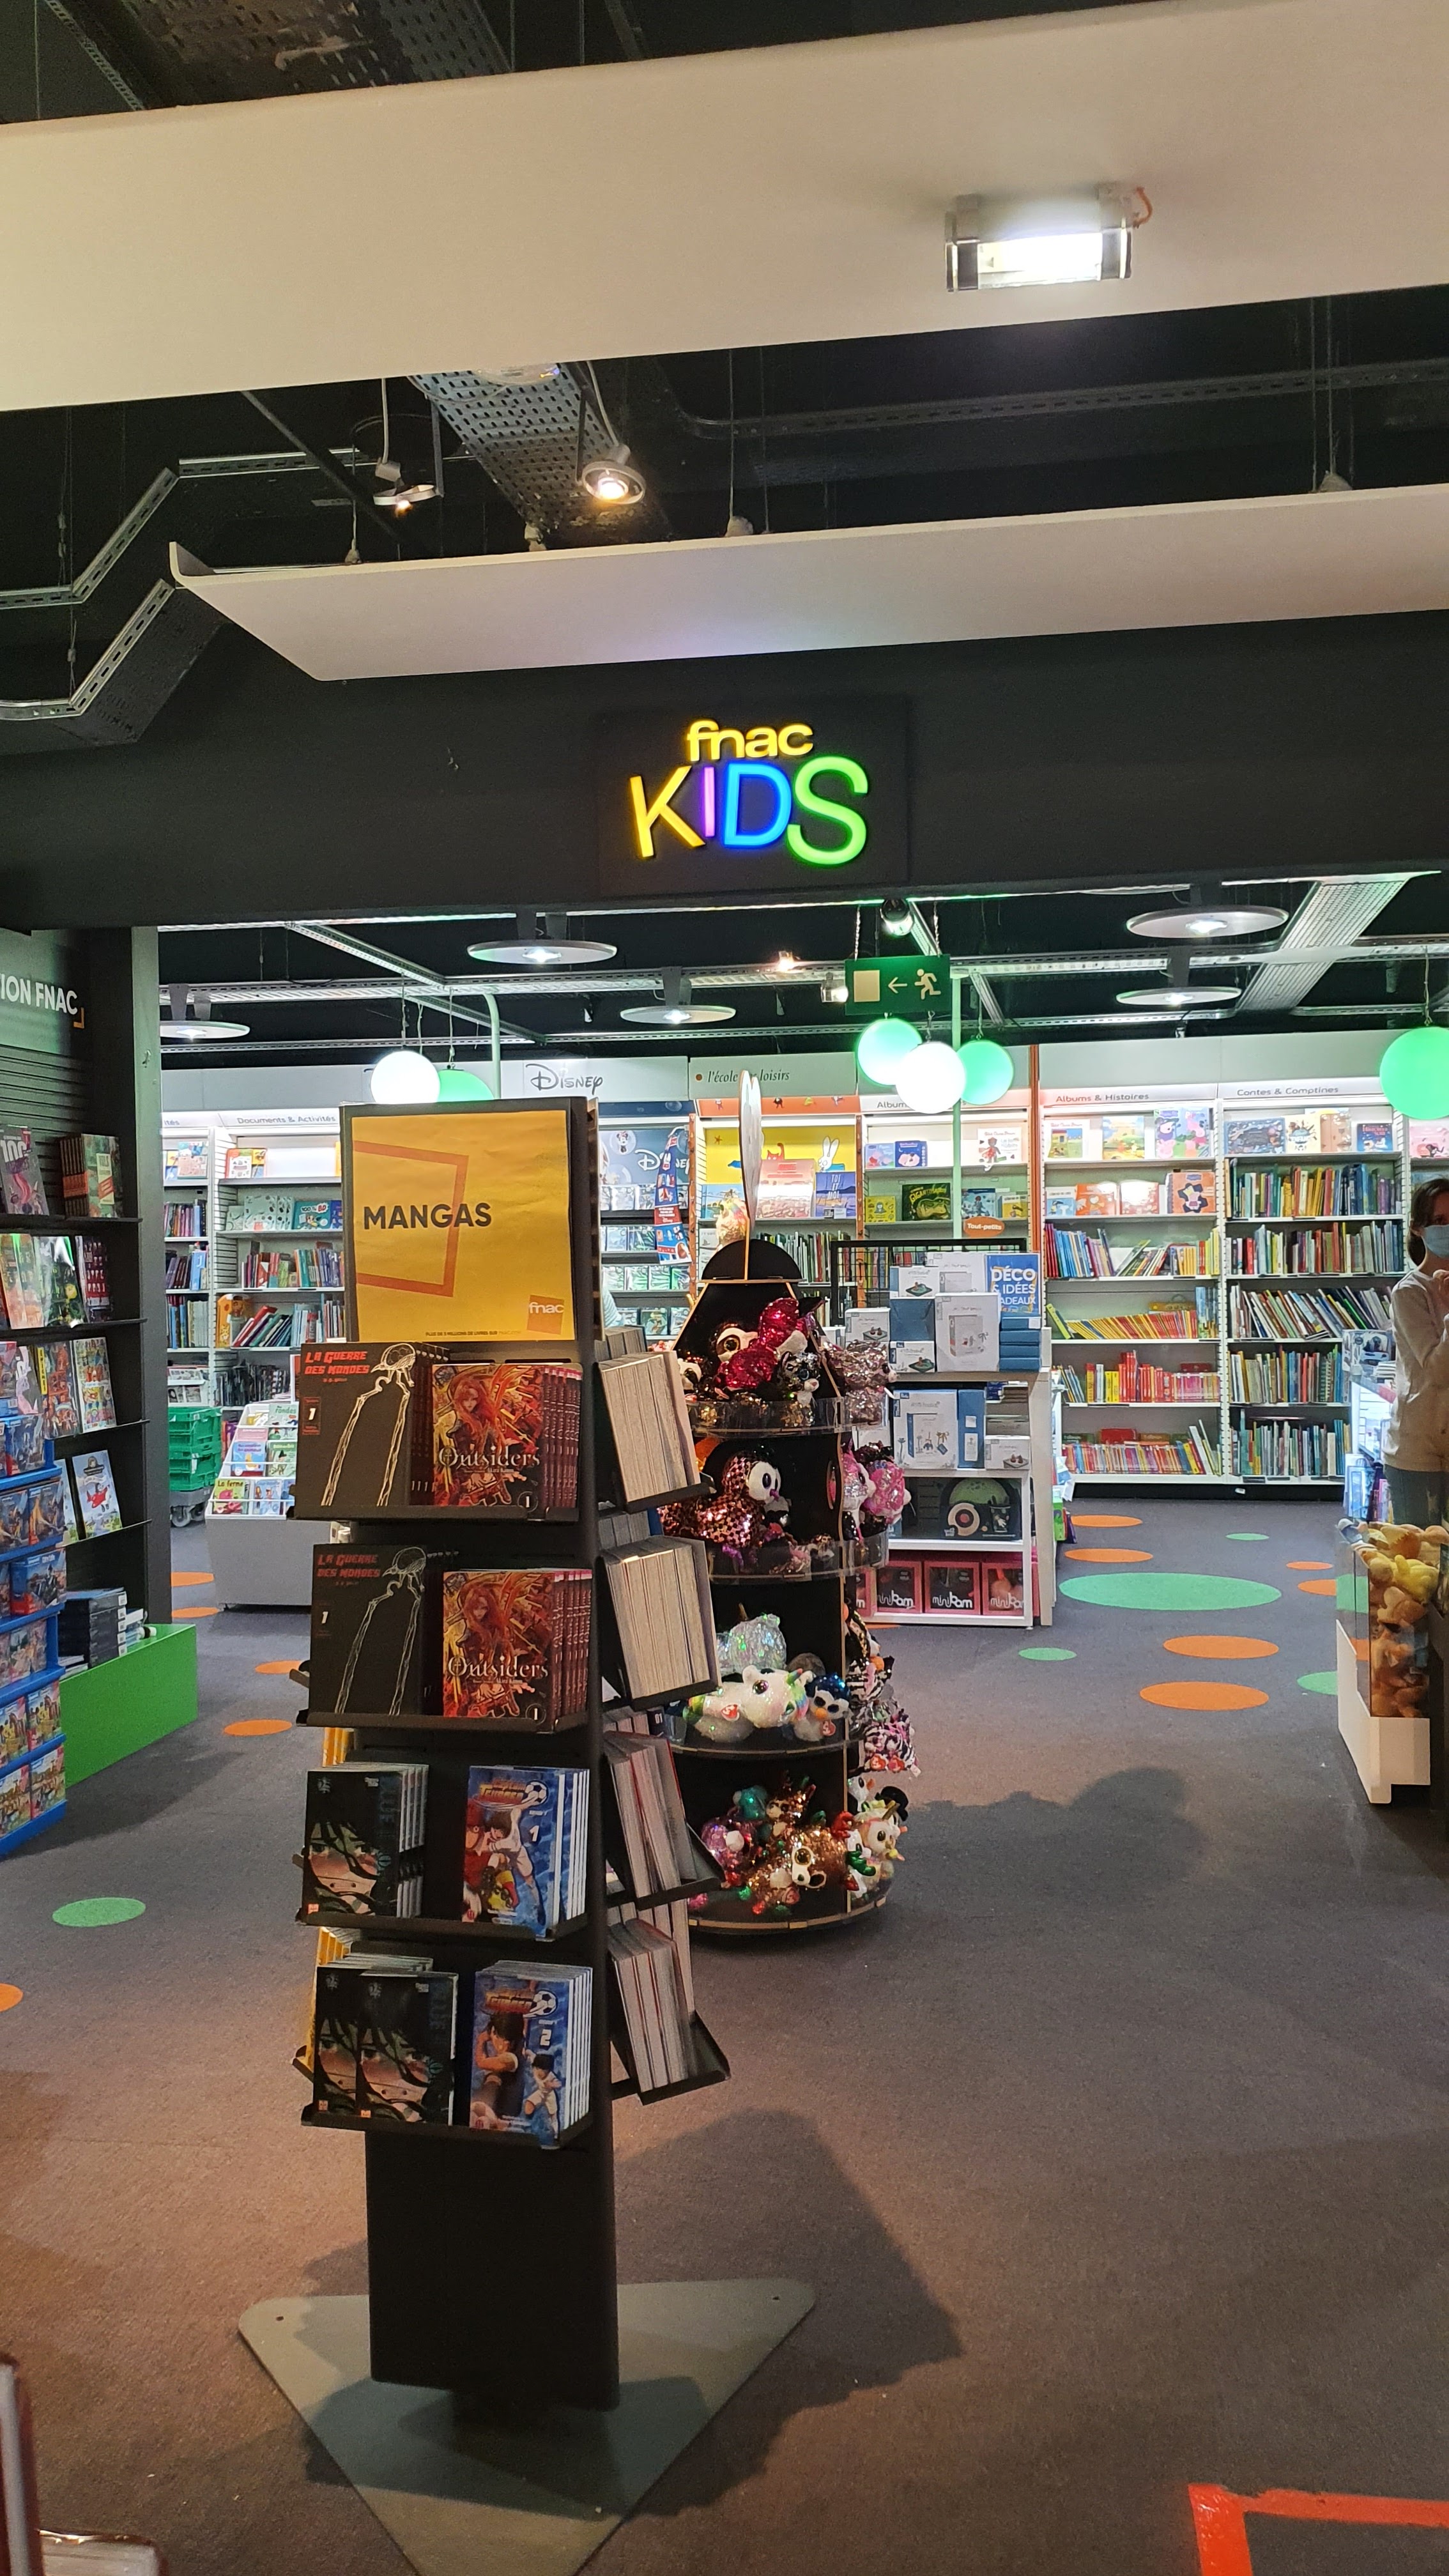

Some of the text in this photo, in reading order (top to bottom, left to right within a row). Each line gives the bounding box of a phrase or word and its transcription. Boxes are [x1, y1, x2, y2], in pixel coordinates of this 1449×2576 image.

[687, 719, 814, 762] fnac
[629, 755, 869, 866] KIDS
[0, 973, 78, 1015] ION FNAC
[708, 1070, 739, 1083] l'école
[760, 1069, 790, 1081] loisirs
[1105, 1093, 1150, 1101] Histoires
[1285, 1087, 1339, 1096] Comptines
[237, 1116, 286, 1124] Documents
[364, 1202, 492, 1230] MANGAS
[991, 1265, 1036, 1282] DÉCO
[1002, 1281, 1036, 1294] IDÉES
[1000, 1296, 1036, 1305] ADEAUX
[528, 1302, 564, 1314] fnac
[323, 1351, 368, 1364] GUERRE
[305, 1365, 371, 1375] DES MONDES
[309, 1407, 316, 1420] 1
[438, 1444, 540, 1469] Outsiders
[227, 1479, 243, 1487] ferme
[335, 1553, 379, 1567] GUERRE
[321, 1611, 328, 1624] 1
[448, 1654, 549, 1680] Outsiders
[529, 1825, 540, 1843] 1
[539, 2028, 553, 2046] 2
